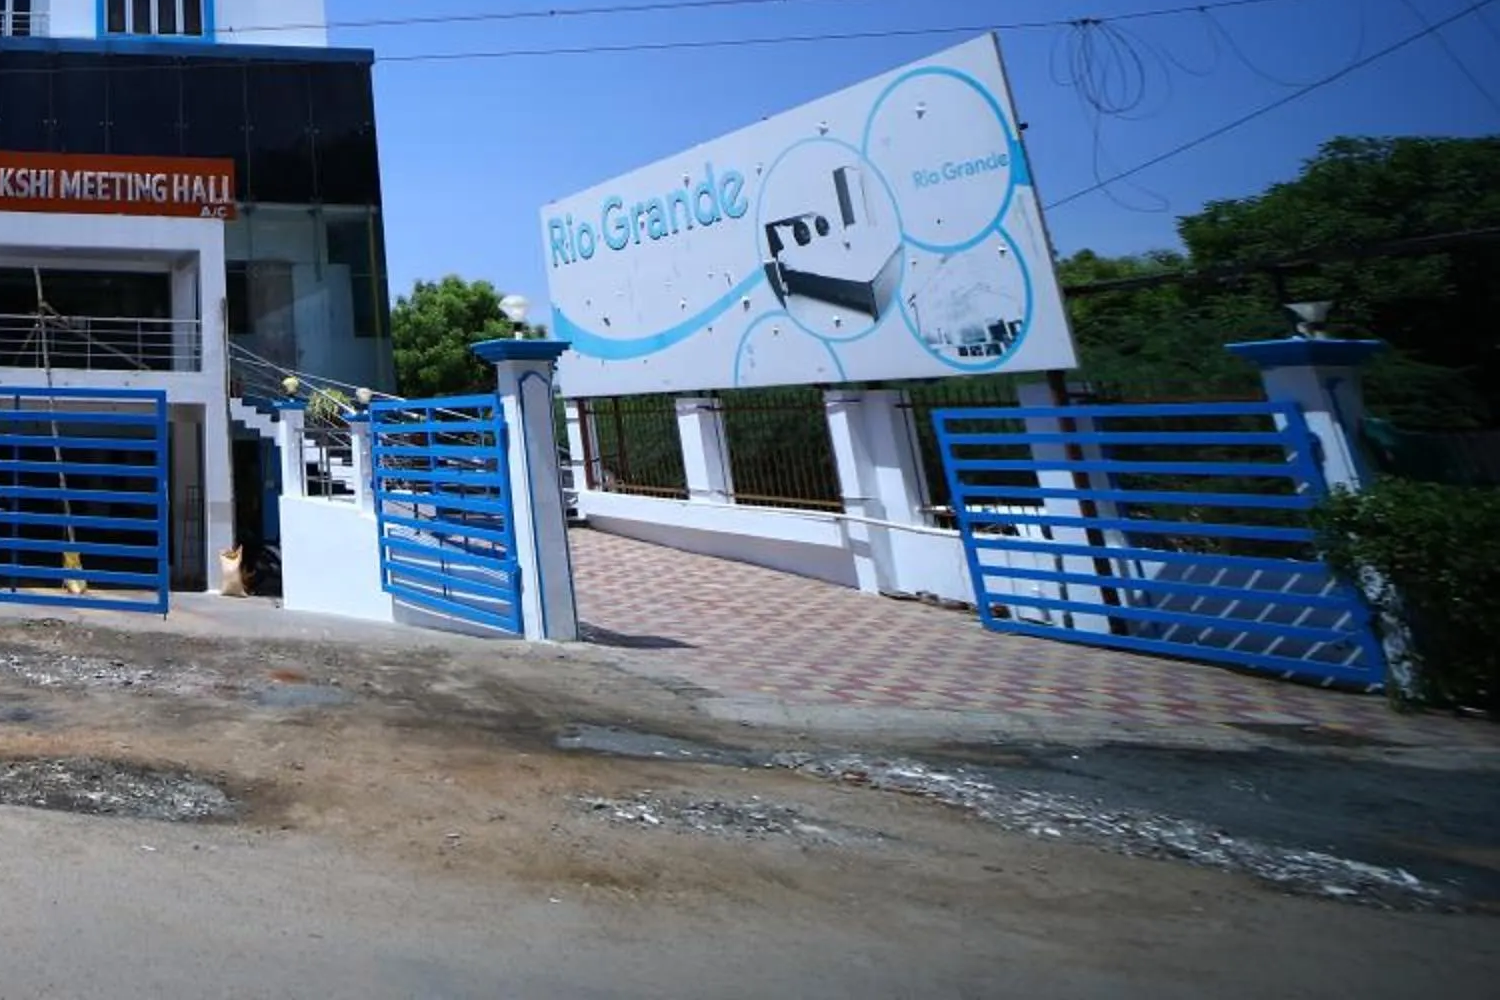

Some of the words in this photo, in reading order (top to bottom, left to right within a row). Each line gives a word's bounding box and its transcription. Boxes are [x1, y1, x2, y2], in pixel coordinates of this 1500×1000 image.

[60, 170, 167, 202] MEETING
[912, 168, 940, 190] Rio
[942, 152, 1009, 180] Grande
[200, 206, 228, 217] A/C
[549, 213, 596, 268] Rio
[602, 161, 749, 251] Grande
